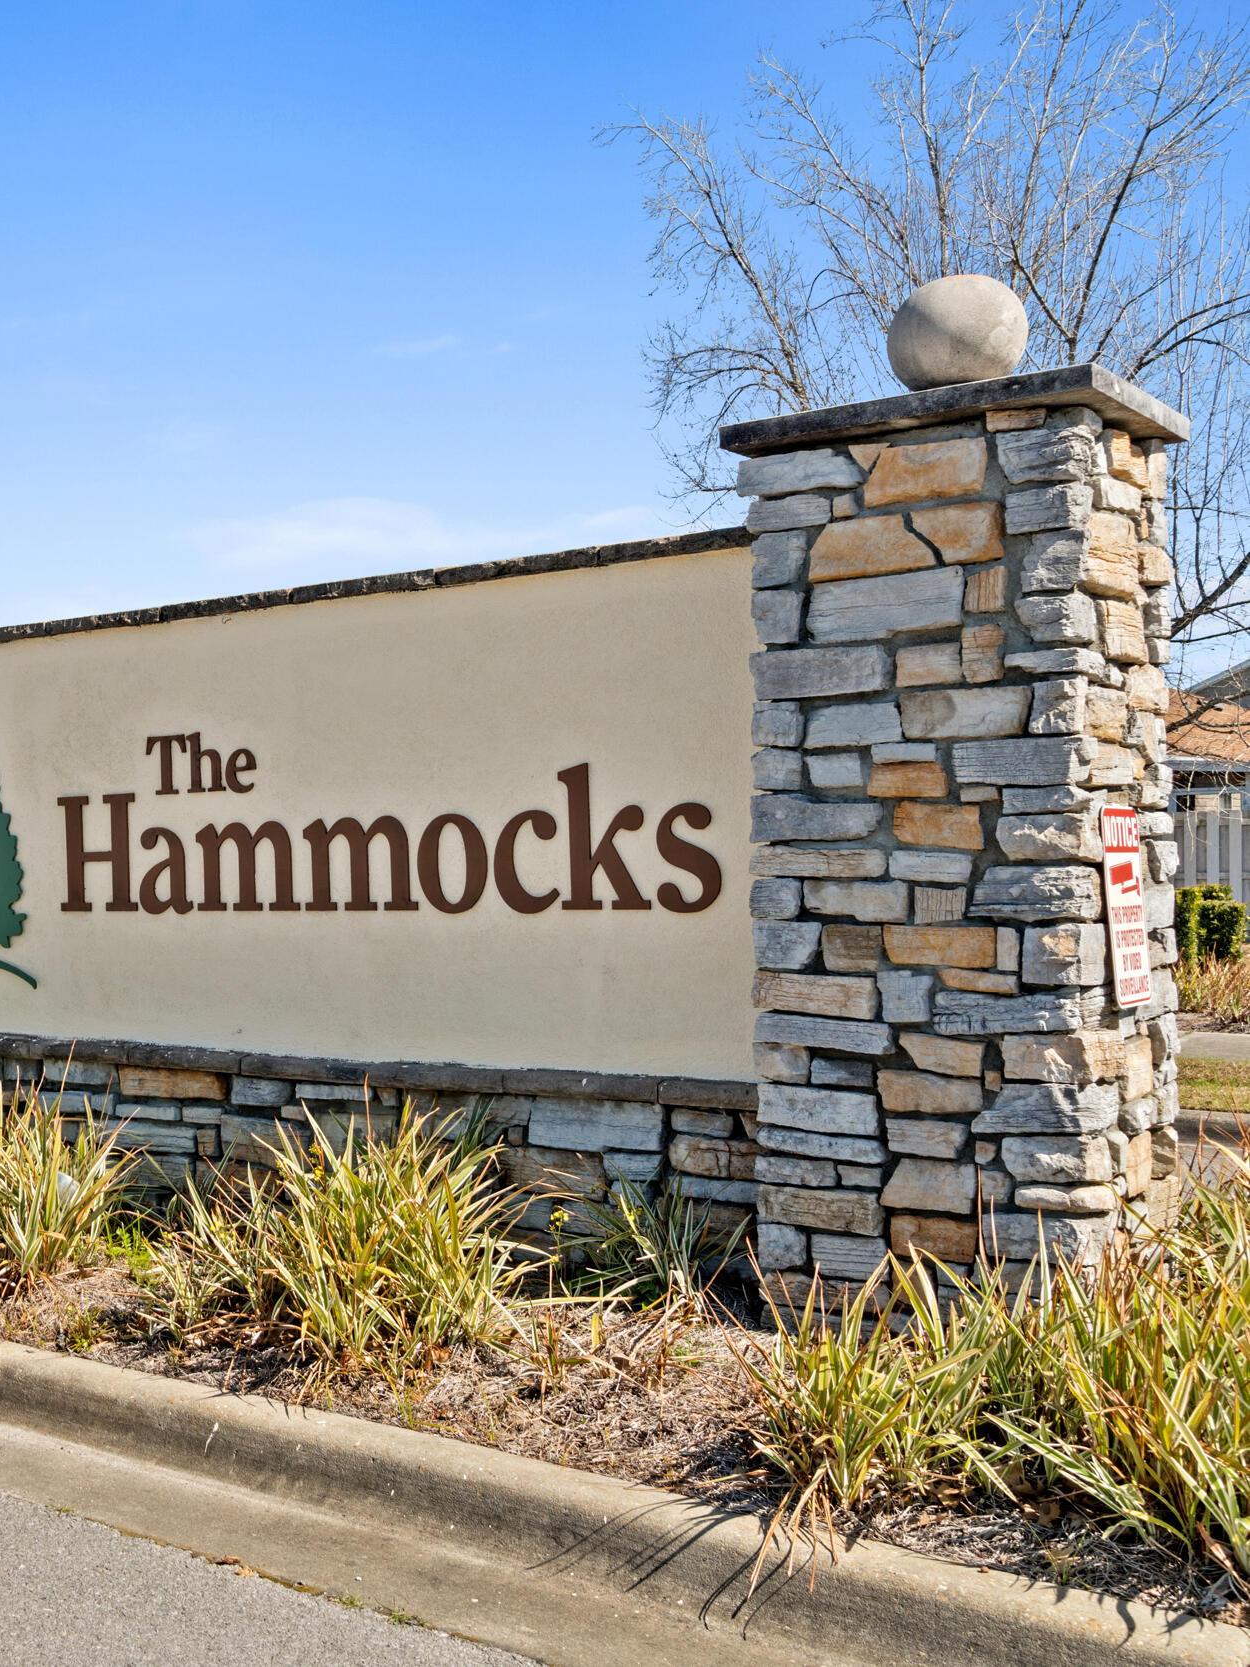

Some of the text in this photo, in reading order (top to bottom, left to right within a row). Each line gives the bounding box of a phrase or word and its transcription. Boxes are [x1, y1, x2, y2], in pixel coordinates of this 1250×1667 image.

[145, 731, 257, 795] The
[56, 762, 722, 915] Hammocks
[1103, 815, 1139, 848] NOTICE
[1111, 905, 1143, 924] THIS PROPERTY
[1121, 928, 1144, 948] PROTECTED
[1122, 952, 1142, 972] BY VIDEO
[1119, 974, 1149, 997] SURVEILLANCE
